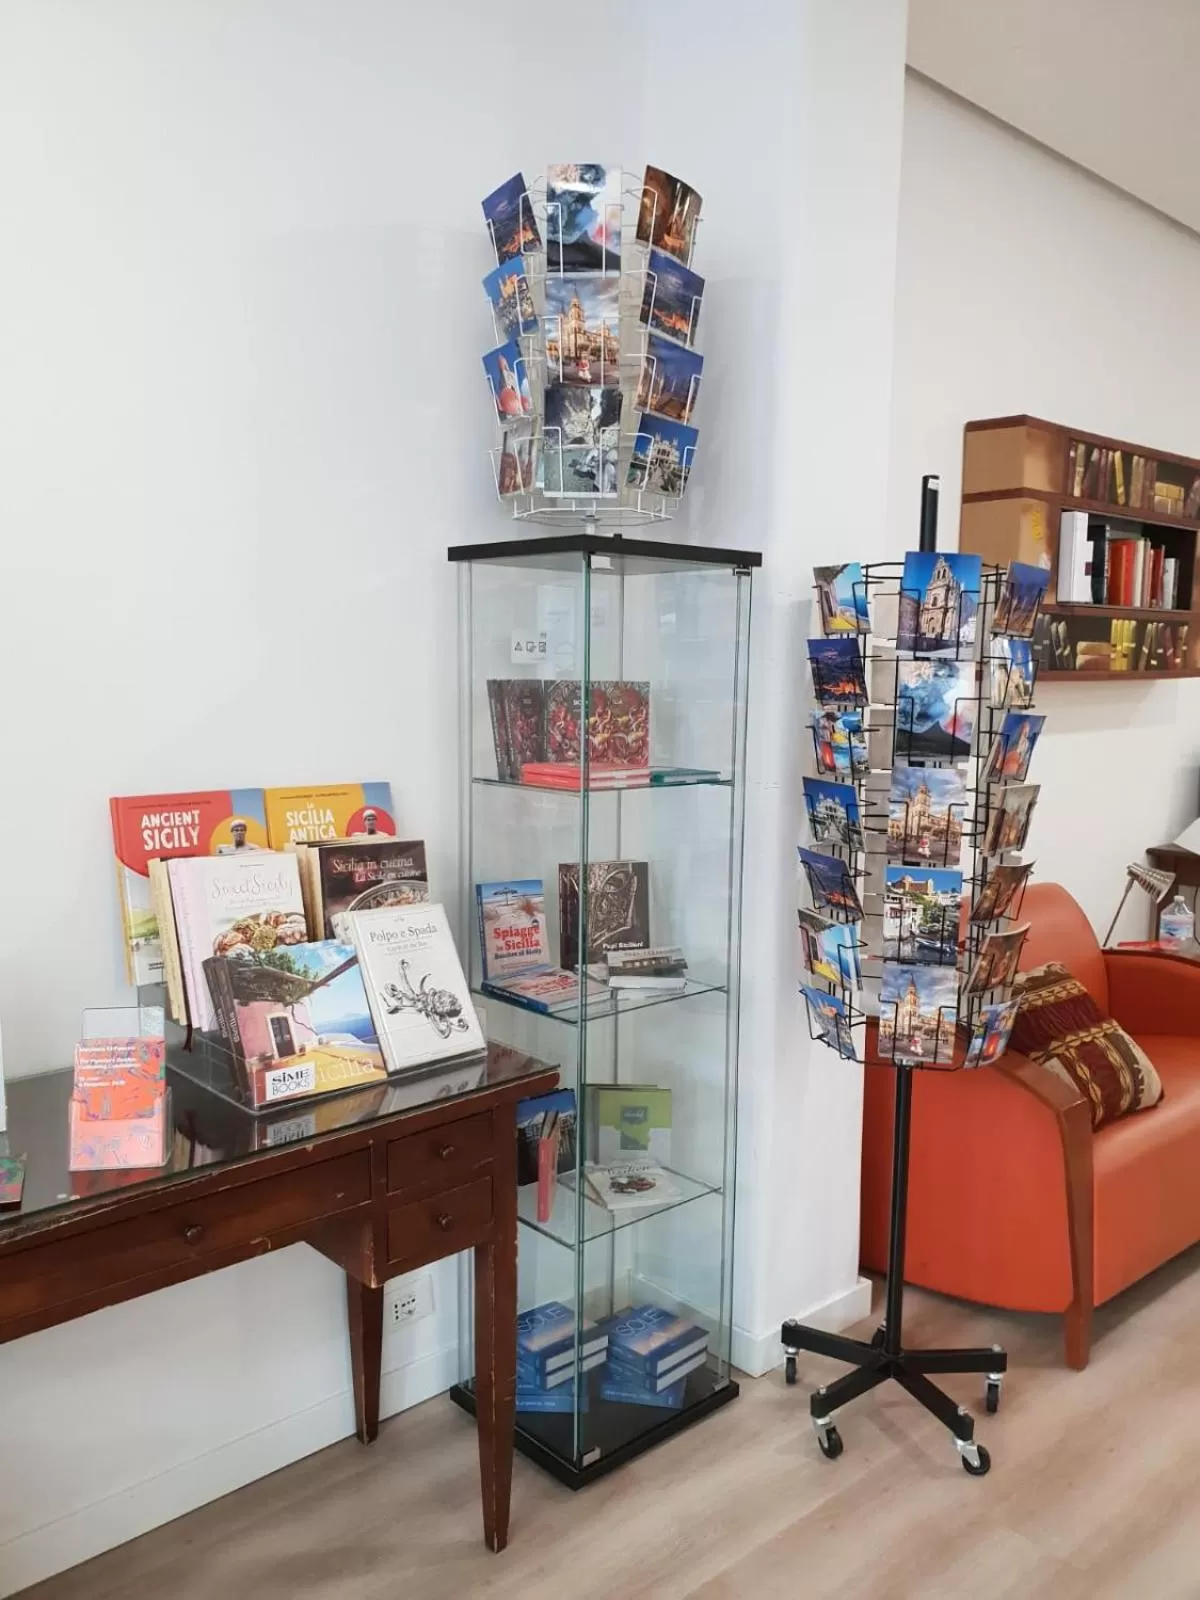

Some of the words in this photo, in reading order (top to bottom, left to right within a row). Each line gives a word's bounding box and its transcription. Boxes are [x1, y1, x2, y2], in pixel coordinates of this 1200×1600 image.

[141, 810, 200, 829] ANCIENT
[286, 809, 335, 826] SICILIA
[142, 826, 200, 851] SICILY
[289, 825, 337, 841] ANTICA
[369, 930, 399, 943] Polpo
[407, 922, 438, 938] Spada
[493, 926, 540, 940] Spiagge
[319, 1057, 376, 1082] icilia
[271, 1079, 312, 1096] BOOKS
[615, 1307, 665, 1337] SOLE
